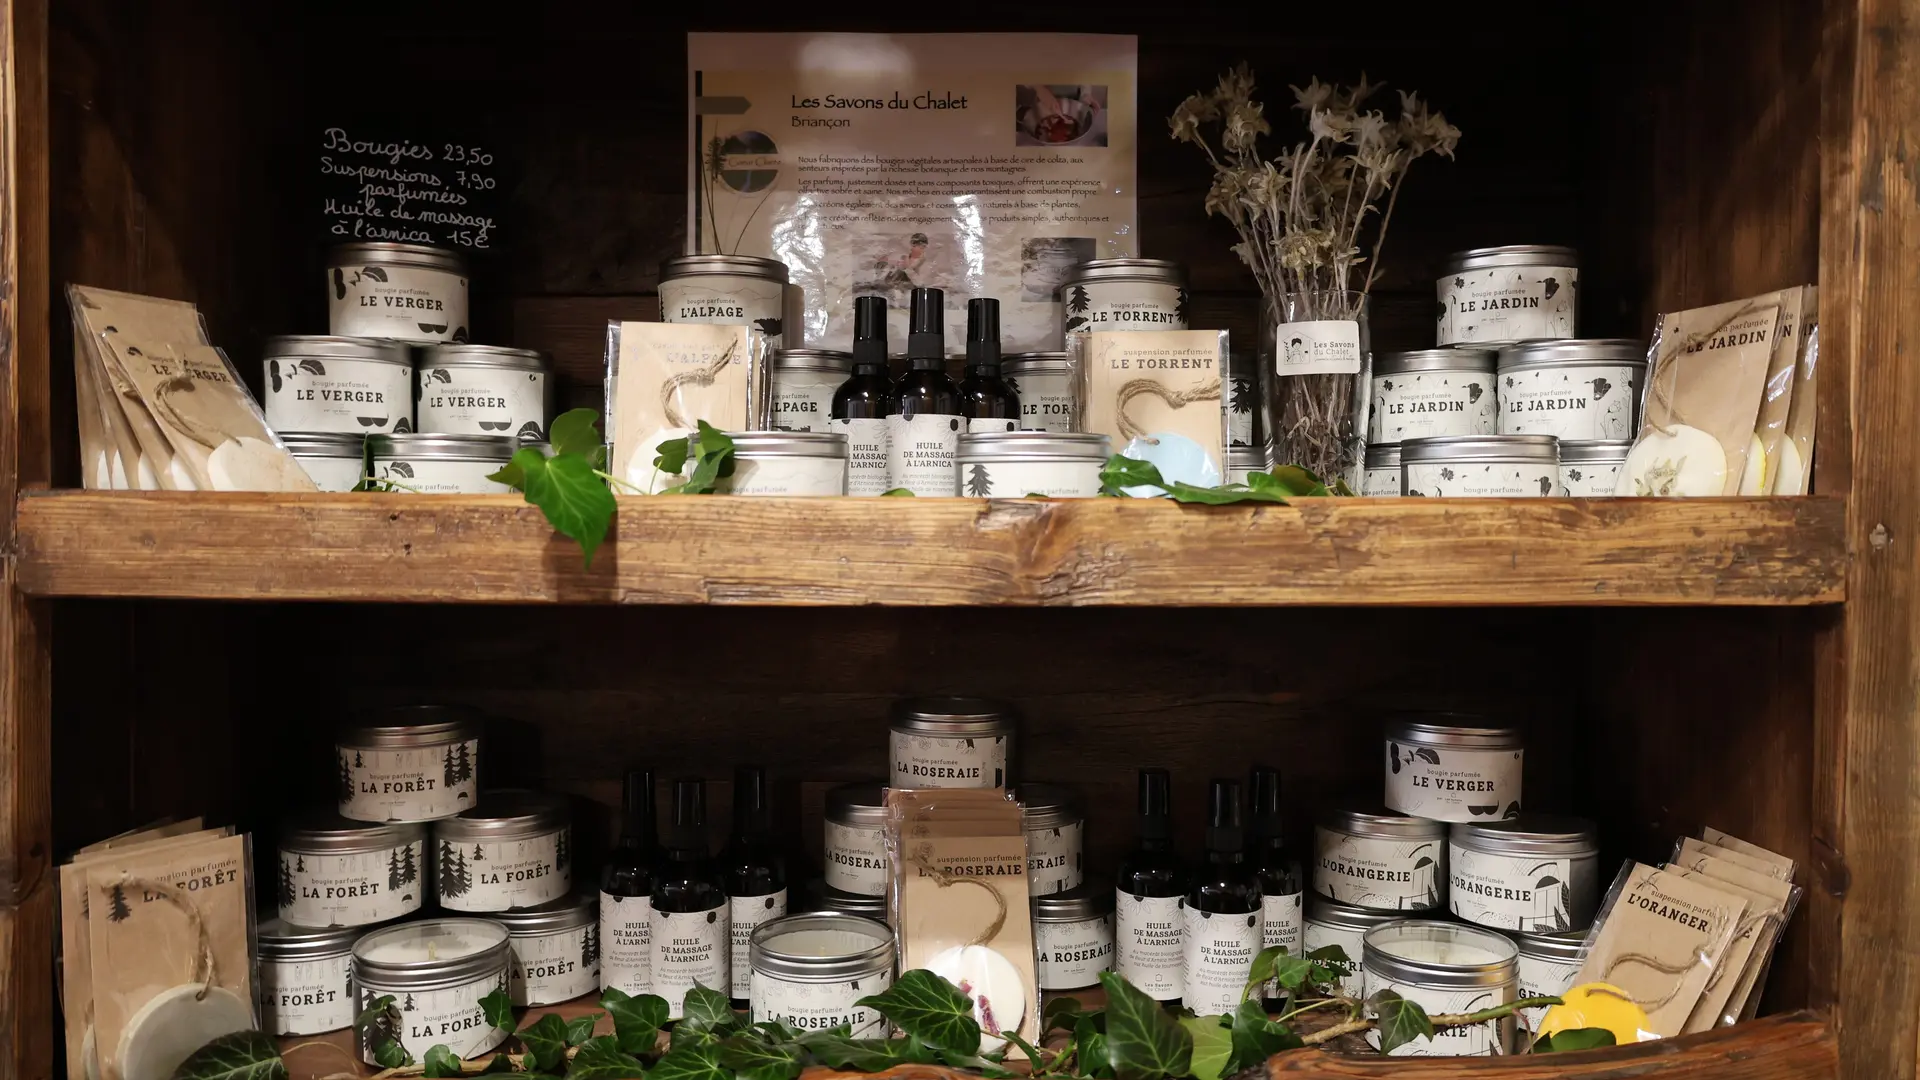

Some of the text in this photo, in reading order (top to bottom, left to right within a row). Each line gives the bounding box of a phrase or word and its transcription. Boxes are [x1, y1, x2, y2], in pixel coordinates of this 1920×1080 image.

[791, 91, 967, 110] Les Savons du Chalet
[791, 115, 850, 130] Briançon
[323, 128, 493, 165] Bougies 23,50
[798, 156, 817, 164] Nous
[861, 155, 874, 164] des
[991, 155, 1009, 164] base
[1010, 155, 1020, 164] de
[1035, 155, 1046, 164] de
[321, 157, 496, 190] Suspensions 7,90
[866, 166, 880, 176] par
[881, 164, 887, 173] la
[959, 164, 970, 173] de
[798, 178, 811, 186] Les
[359, 183, 467, 206] parfumées
[324, 198, 496, 237] Huile de massage
[331, 220, 349, 235] à
[355, 218, 435, 243] l'arnica
[360, 295, 444, 311] LE VERGER
[1460, 297, 1540, 313] LE JARDIN
[680, 306, 744, 319] L'ALPAGE
[1092, 311, 1174, 324] LE TORRENT
[1329, 341, 1355, 349] Savons
[1709, 330, 1767, 350] JARDIN
[1123, 347, 1213, 357] suspension parfumée
[1111, 358, 1213, 370] LE TORRENT
[311, 380, 370, 389] bougie parfumée
[297, 389, 384, 403] LE VERGER
[1539, 390, 1572, 398] parfumée
[431, 397, 506, 408] LE VERGER
[1389, 401, 1464, 414] LE JARDIN
[1510, 398, 1587, 413] LE JARDIN
[1023, 404, 1037, 414] LE
[916, 442, 943, 450] HUILE
[906, 459, 912, 467] À
[1463, 486, 1523, 494] bougie parfumée
[897, 762, 979, 778] LA ROSERAIE
[1427, 768, 1448, 778] bougie
[361, 777, 436, 794] LA FORÊT
[1413, 776, 1495, 792] LE VERGER
[491, 859, 543, 871] bougie parfumée
[936, 854, 1022, 864] suspension parfumée
[1357, 858, 1387, 867] parfumée
[481, 864, 551, 885] LA FORÊT
[1322, 858, 1411, 882] L'ORANGERIE
[311, 876, 368, 886] bougie parfumée
[302, 882, 379, 898] LA FORÊT
[1627, 892, 1709, 934] L'ORANGER
[1146, 922, 1172, 930] HUILE
[1265, 928, 1298, 936] MASSAGE
[1146, 929, 1182, 938] MASSAGE
[672, 937, 699, 945] HUILE
[1074, 940, 1099, 948] parfumée
[1137, 936, 1180, 946] À L'ARNICA
[1213, 940, 1240, 948] HUILE
[672, 944, 712, 954] MASSAGE
[1054, 943, 1111, 963] ROSERAIE
[1213, 947, 1251, 956] MASSAGE
[663, 953, 709, 963] À L'ARNICA
[1204, 954, 1249, 965] À L'ARNICA
[527, 959, 575, 978] FORÊT
[282, 990, 336, 1006] FORÊT
[787, 1005, 842, 1015] bougie parfumée
[412, 1025, 433, 1038] LA
